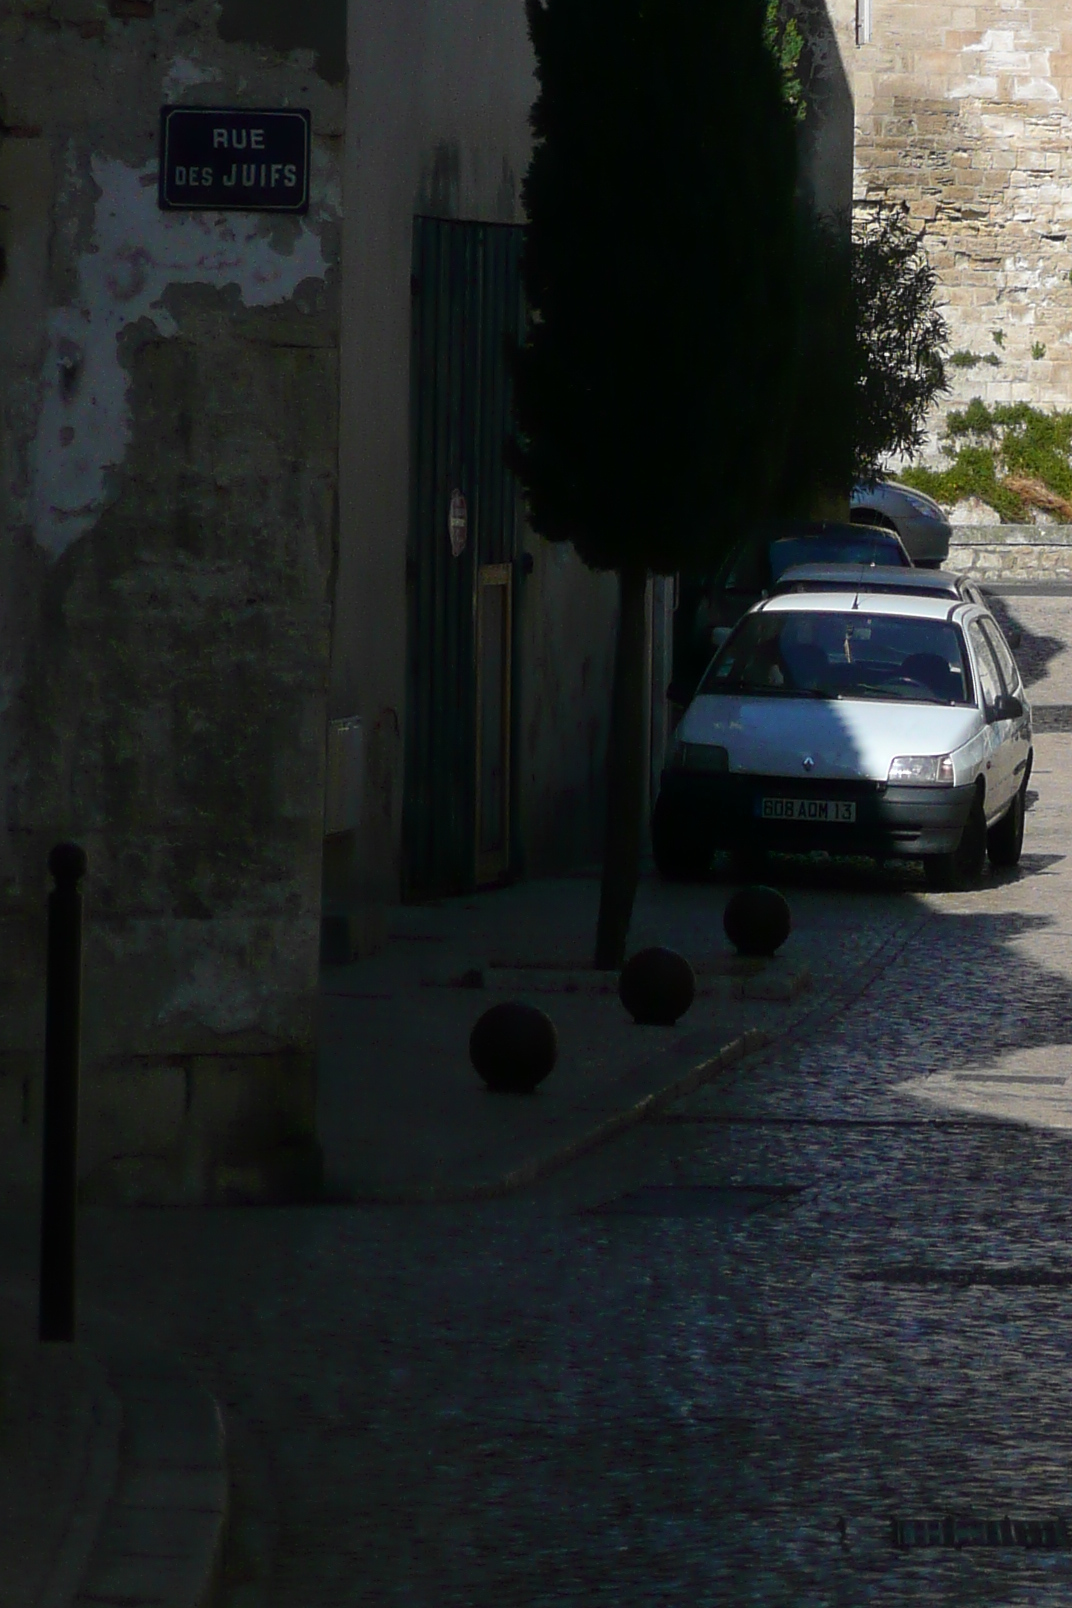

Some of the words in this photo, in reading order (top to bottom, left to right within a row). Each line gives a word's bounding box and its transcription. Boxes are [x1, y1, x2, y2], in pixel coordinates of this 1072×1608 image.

[213, 128, 265, 149] RUE
[175, 166, 213, 186] DES
[222, 163, 297, 187] JUIFS
[763, 800, 794, 817] 608
[834, 803, 852, 820] 13
